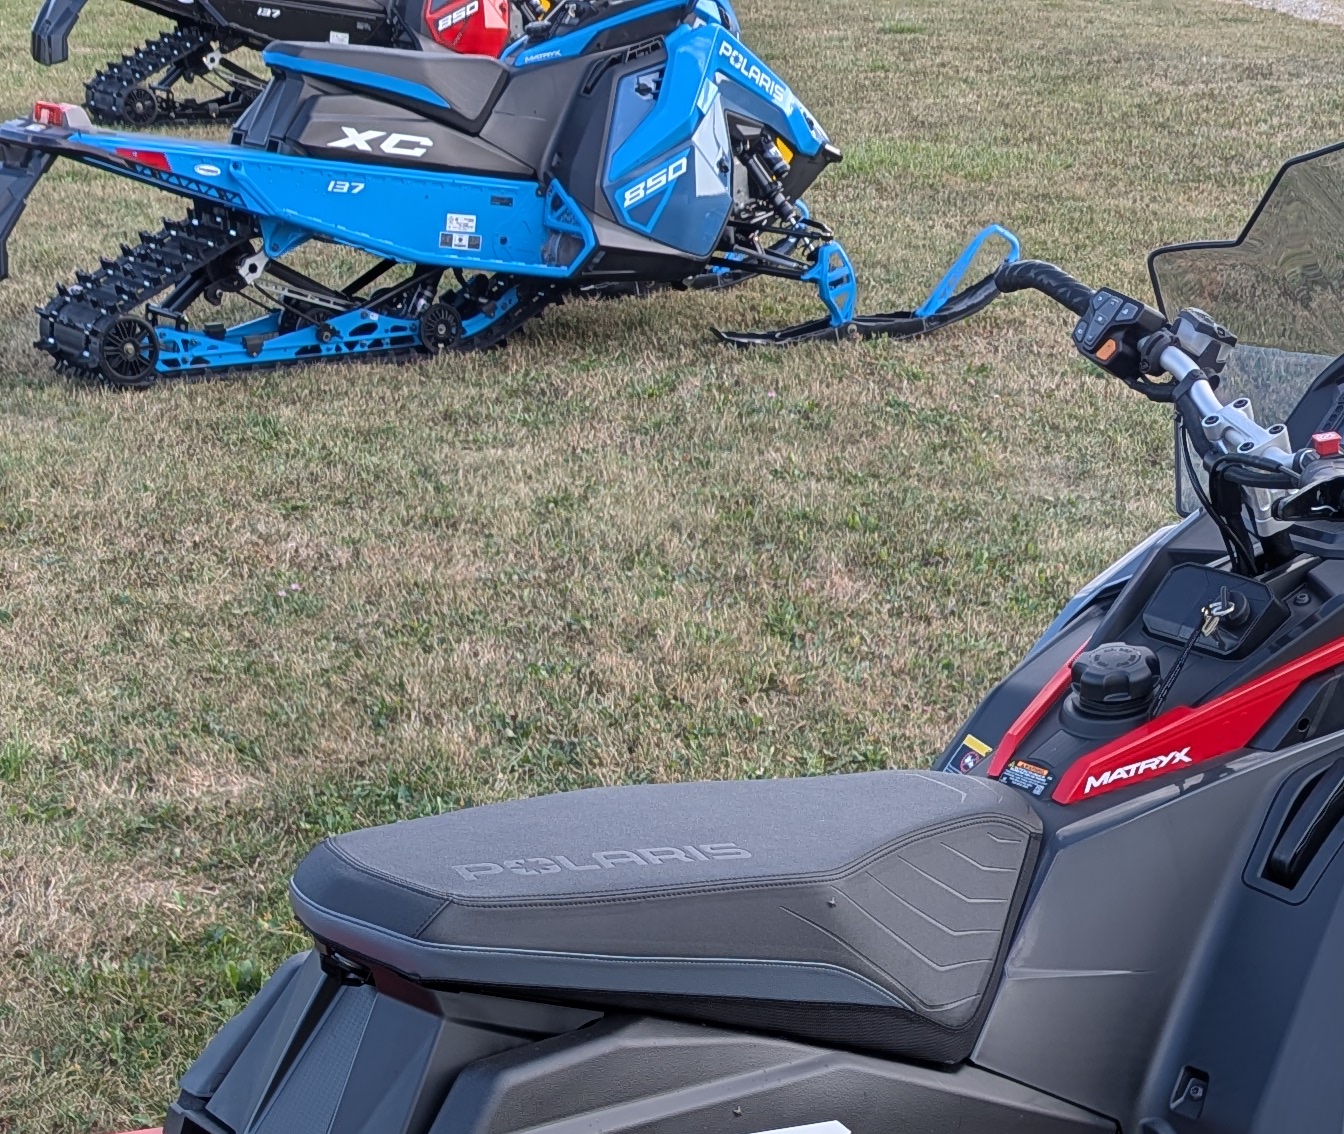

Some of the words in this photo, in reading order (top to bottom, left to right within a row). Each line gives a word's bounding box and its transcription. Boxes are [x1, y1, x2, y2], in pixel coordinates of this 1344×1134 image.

[257, 7, 281, 18] 137
[438, 1, 479, 31] 850
[719, 41, 786, 102] POLARIS
[326, 126, 434, 157] XC
[327, 180, 365, 194] 137
[623, 156, 688, 208] 850
[1084, 746, 1193, 794] MATRYX
[452, 842, 752, 881] POLARIS
